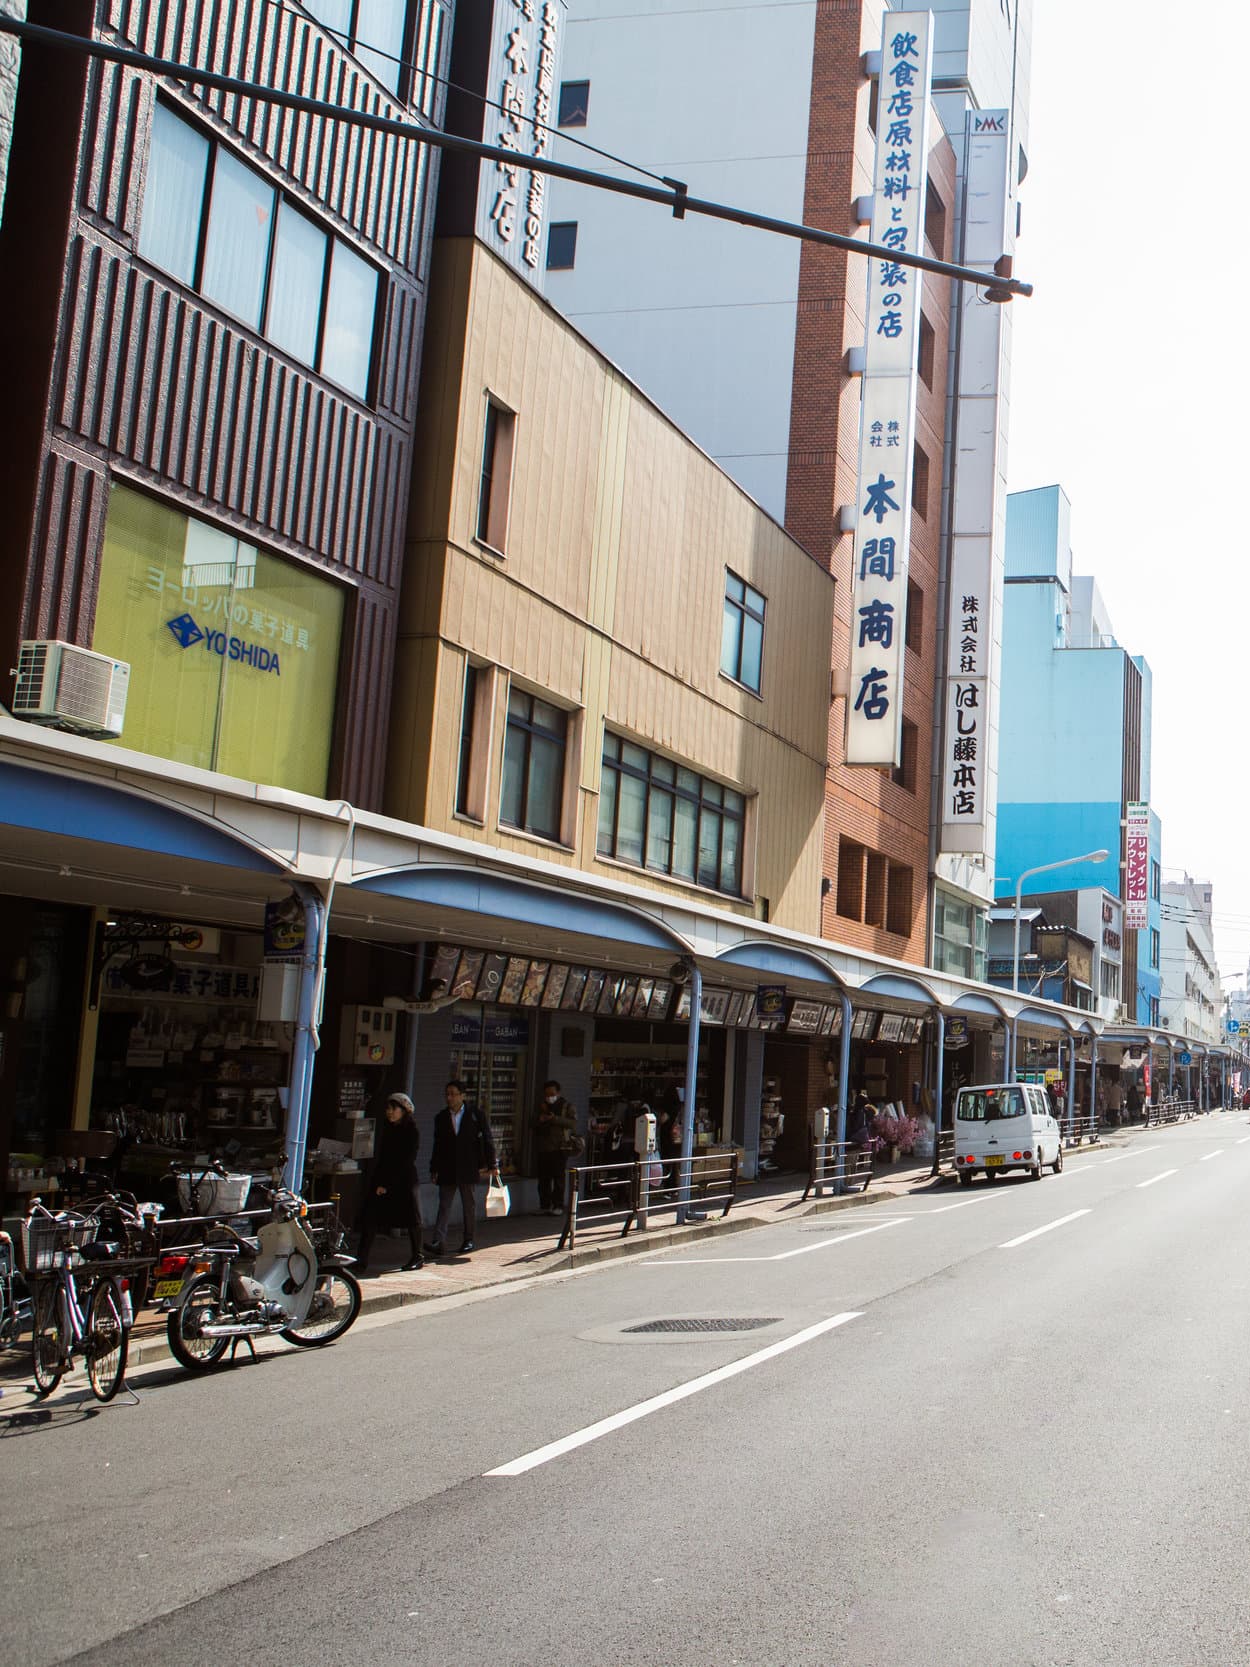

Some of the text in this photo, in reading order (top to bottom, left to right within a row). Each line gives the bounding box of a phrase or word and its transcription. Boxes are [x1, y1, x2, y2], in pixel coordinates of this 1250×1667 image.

[854, 473, 901, 721] 本間商店
[205, 626, 281, 677] YOSHIDA
[959, 595, 980, 674] 株式会社
[952, 682, 981, 815] はし藤本店
[1127, 838, 1137, 899] アウトレット
[1137, 838, 1147, 899] リサイクル
